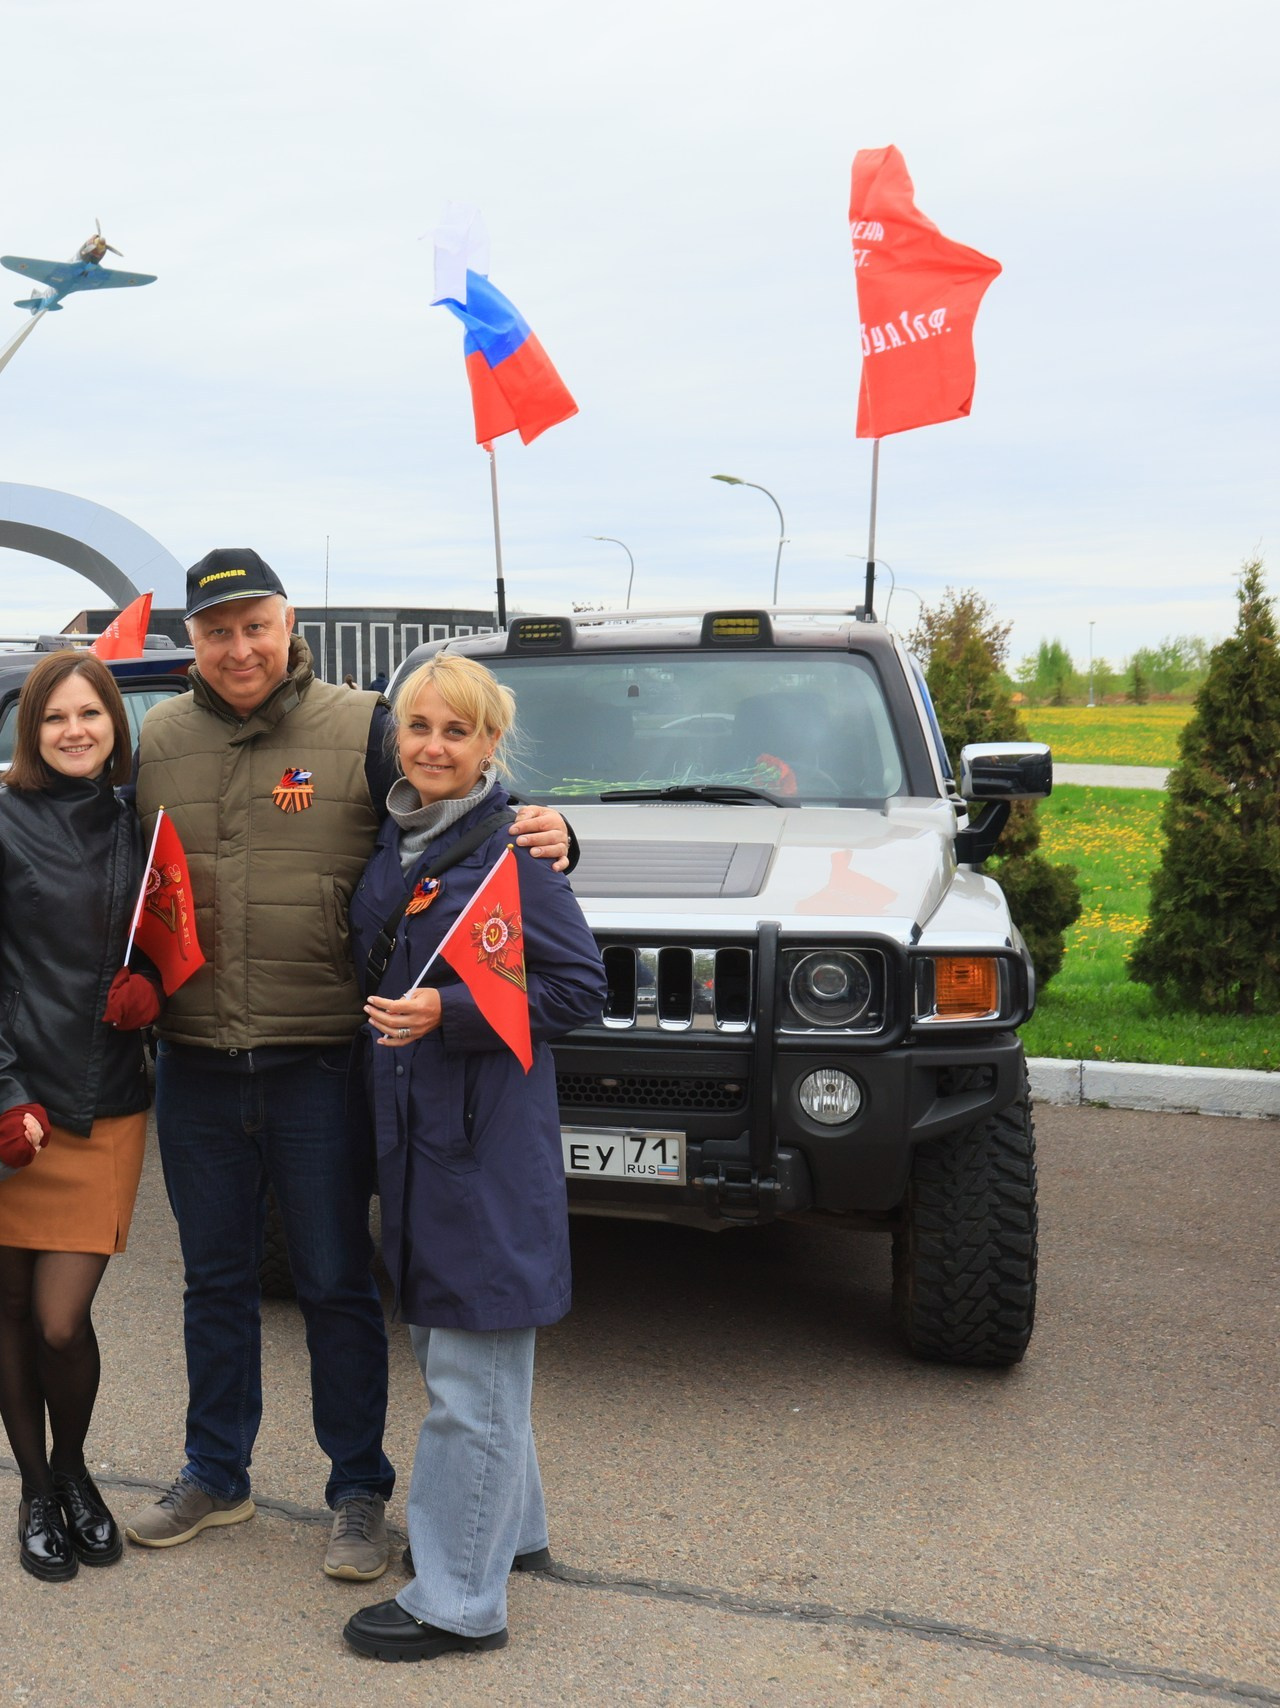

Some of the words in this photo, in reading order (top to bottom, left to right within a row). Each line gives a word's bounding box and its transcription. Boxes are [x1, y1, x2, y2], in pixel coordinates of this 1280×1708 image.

[199, 569, 246, 588] HUMMER
[630, 1138, 667, 1164] 71
[627, 1164, 656, 1174] RUS
